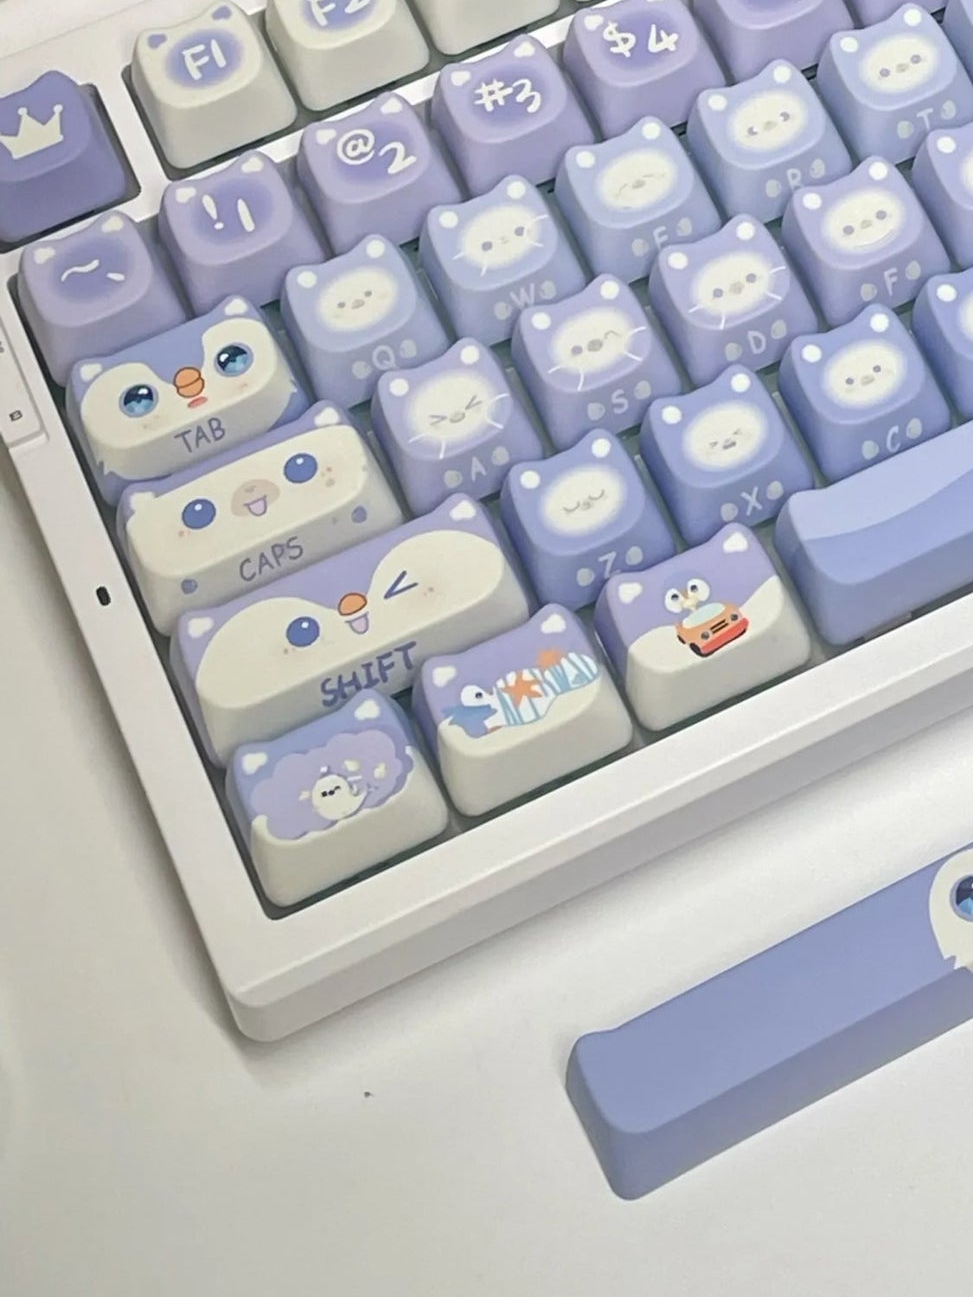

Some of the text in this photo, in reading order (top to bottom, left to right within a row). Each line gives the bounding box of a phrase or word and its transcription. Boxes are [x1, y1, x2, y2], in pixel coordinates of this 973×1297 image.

[182, 40, 226, 80] F1
[916, 108, 934, 131] T
[510, 283, 536, 308] W
[883, 268, 899, 297] F
[748, 330, 766, 354] D
[372, 345, 397, 371] Q
[611, 389, 629, 414] S
[175, 417, 226, 454] TAB
[886, 426, 899, 452] C
[470, 457, 487, 483] A
[741, 486, 763, 516] X
[239, 536, 304, 582] CAPS
[320, 641, 418, 708] SHIFT
